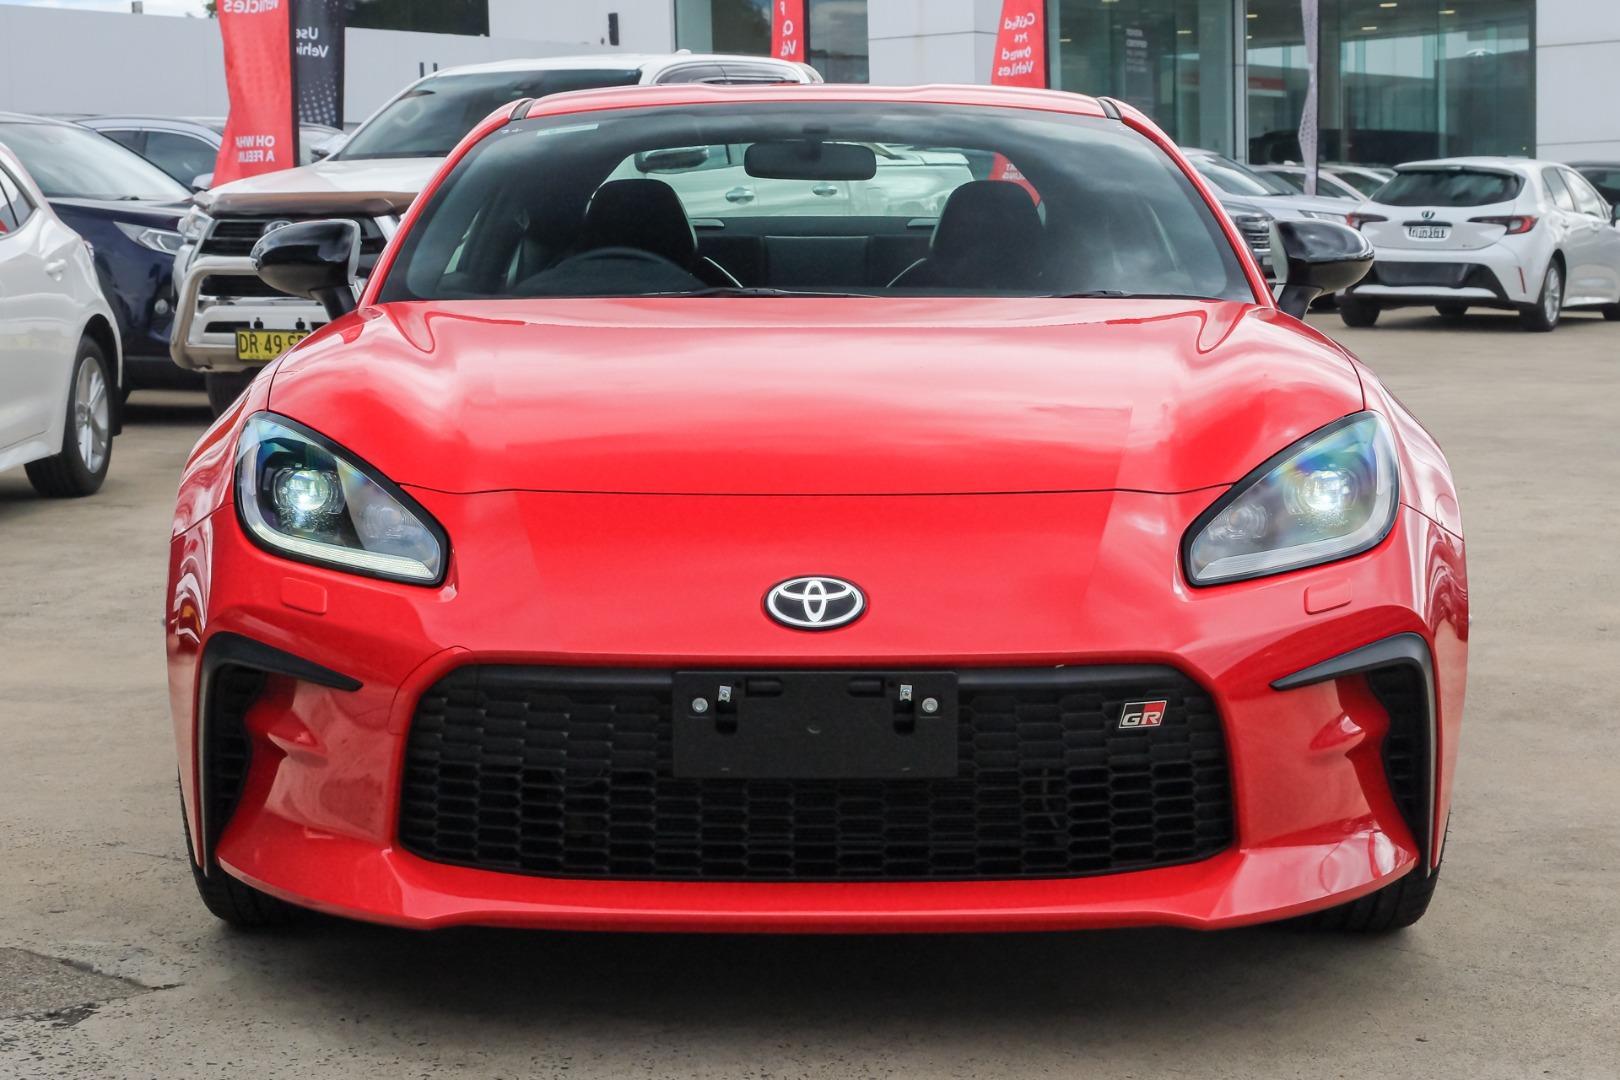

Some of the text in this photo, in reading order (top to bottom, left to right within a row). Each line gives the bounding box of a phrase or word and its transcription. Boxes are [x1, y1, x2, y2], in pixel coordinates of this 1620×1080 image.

[239, 333, 259, 353] DR
[264, 334, 282, 354] 49
[1122, 711, 1161, 726] GR
